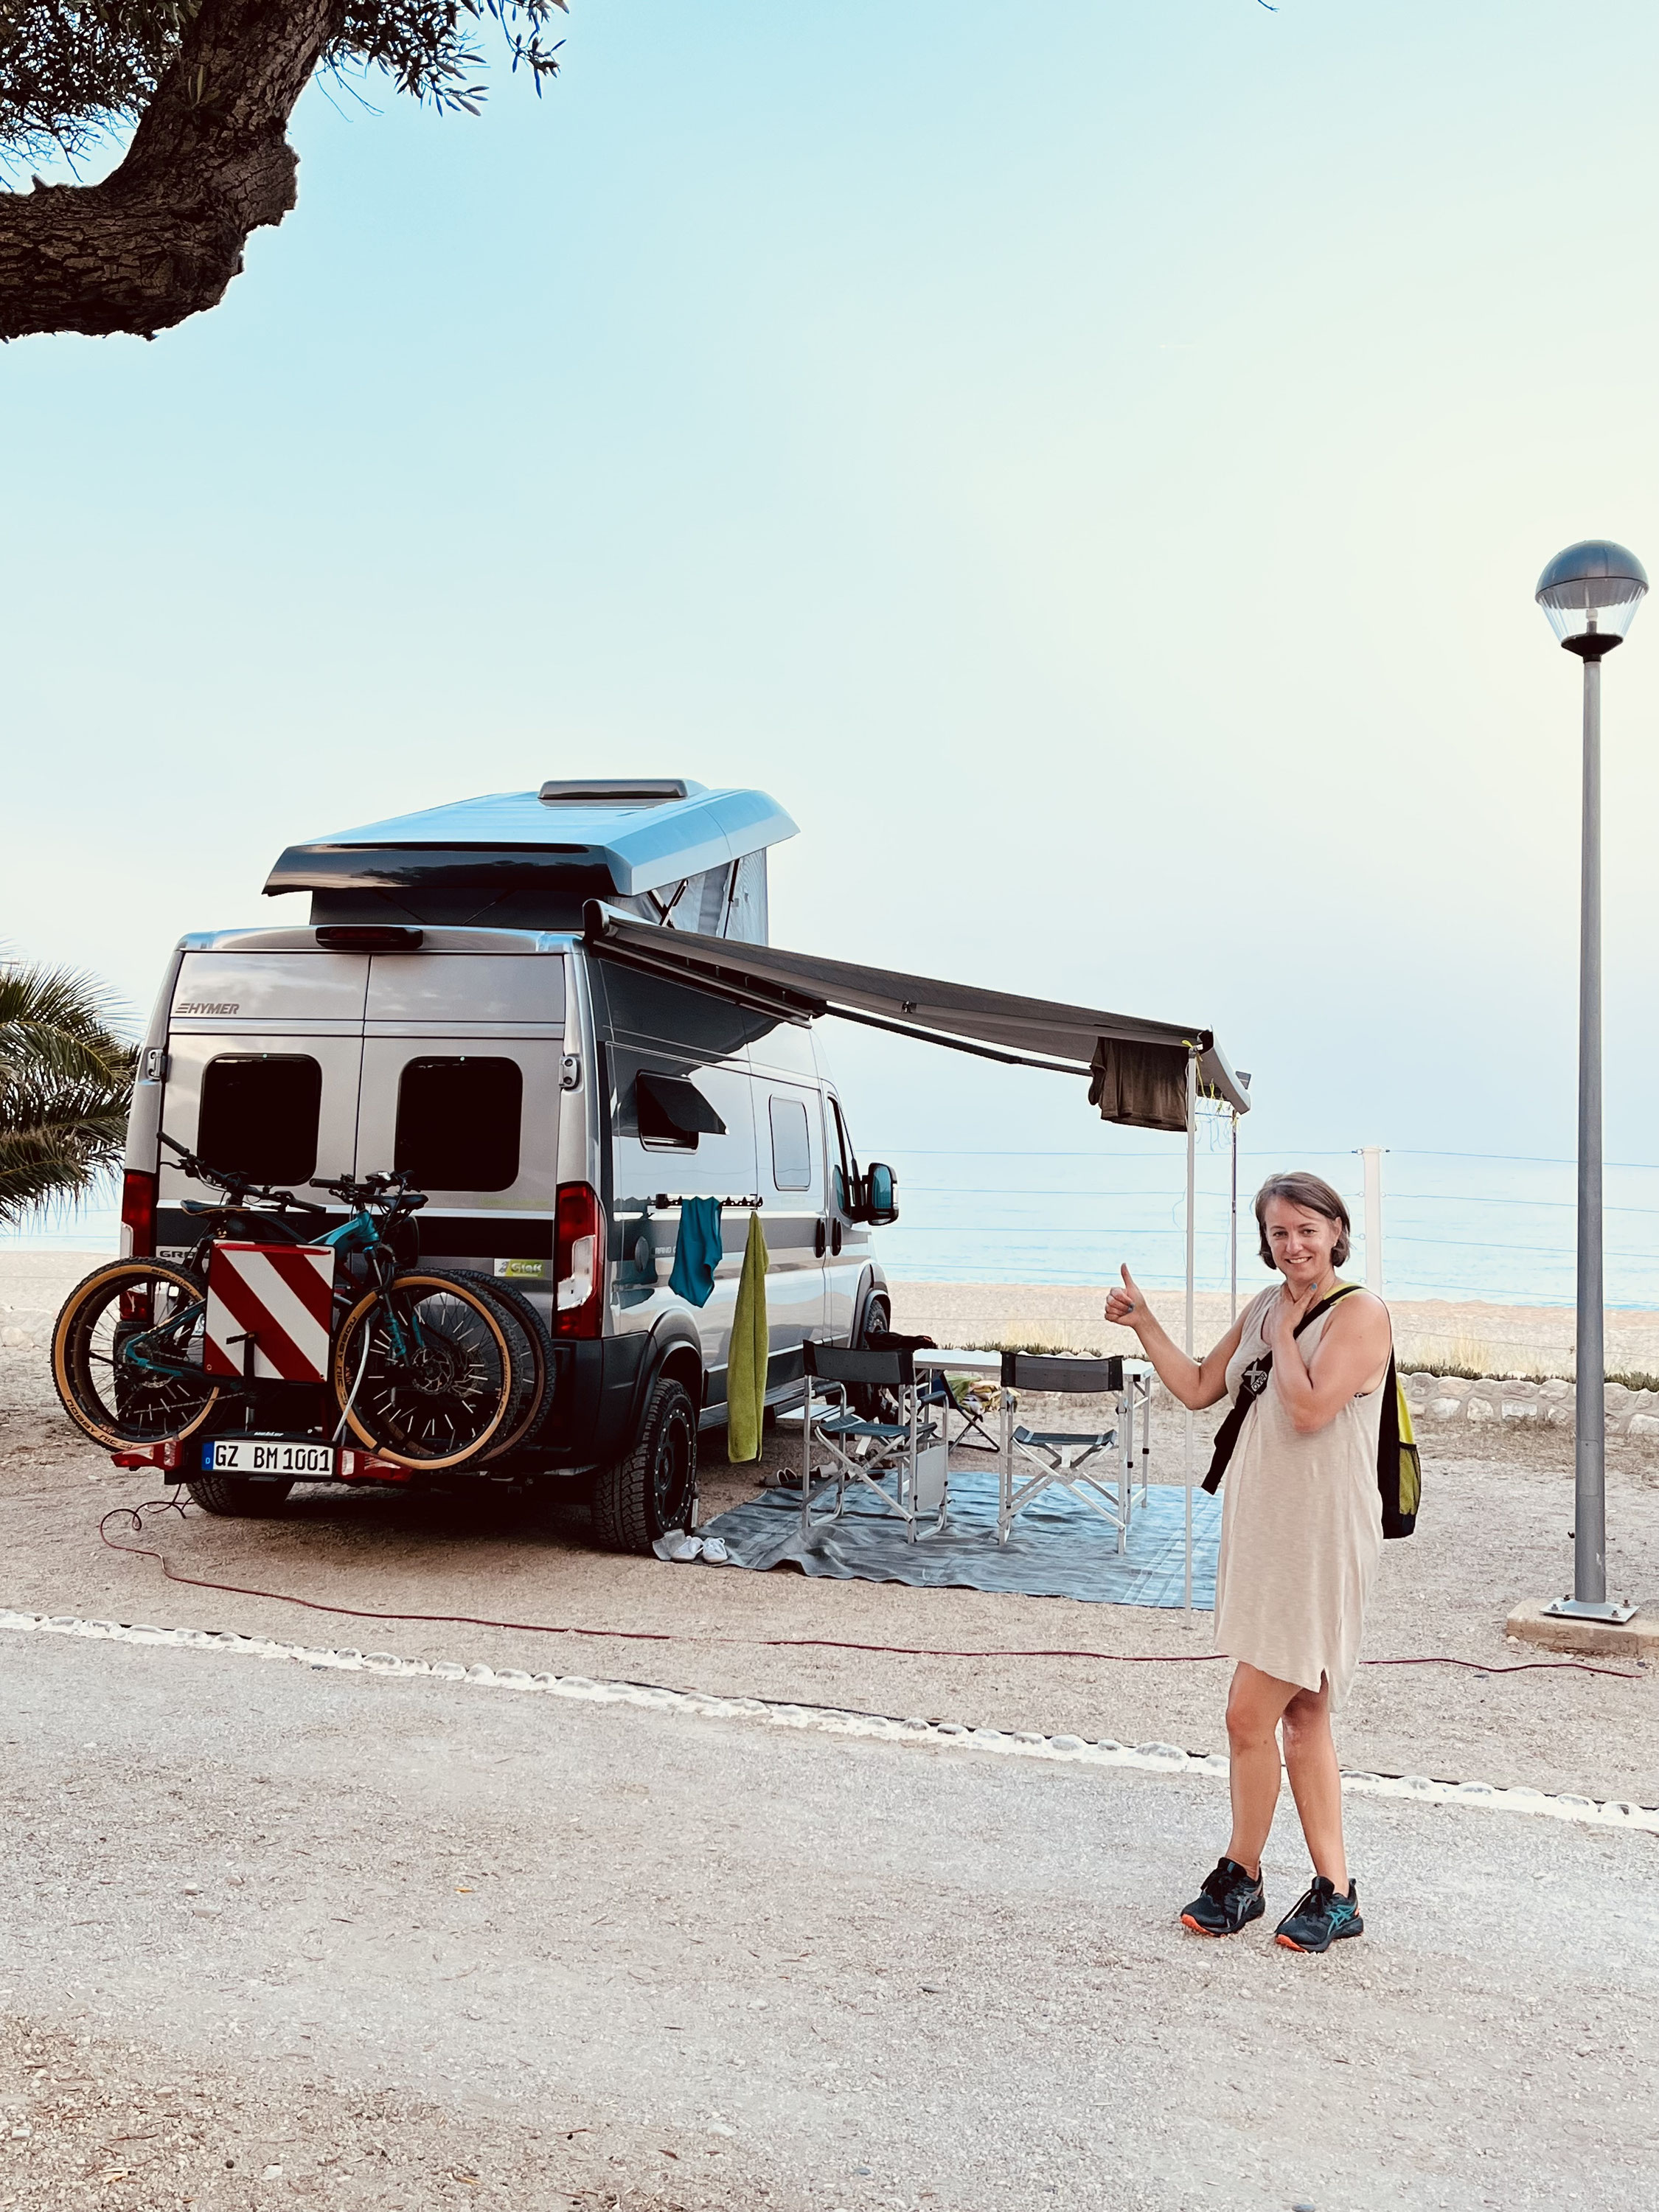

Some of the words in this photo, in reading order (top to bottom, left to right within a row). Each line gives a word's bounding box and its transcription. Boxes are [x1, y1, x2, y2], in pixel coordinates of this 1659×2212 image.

[187, 1003, 240, 1015] HYMER
[215, 1444, 239, 1468] GZ
[254, 1447, 279, 1470] BM
[283, 1447, 330, 1472] 1001
